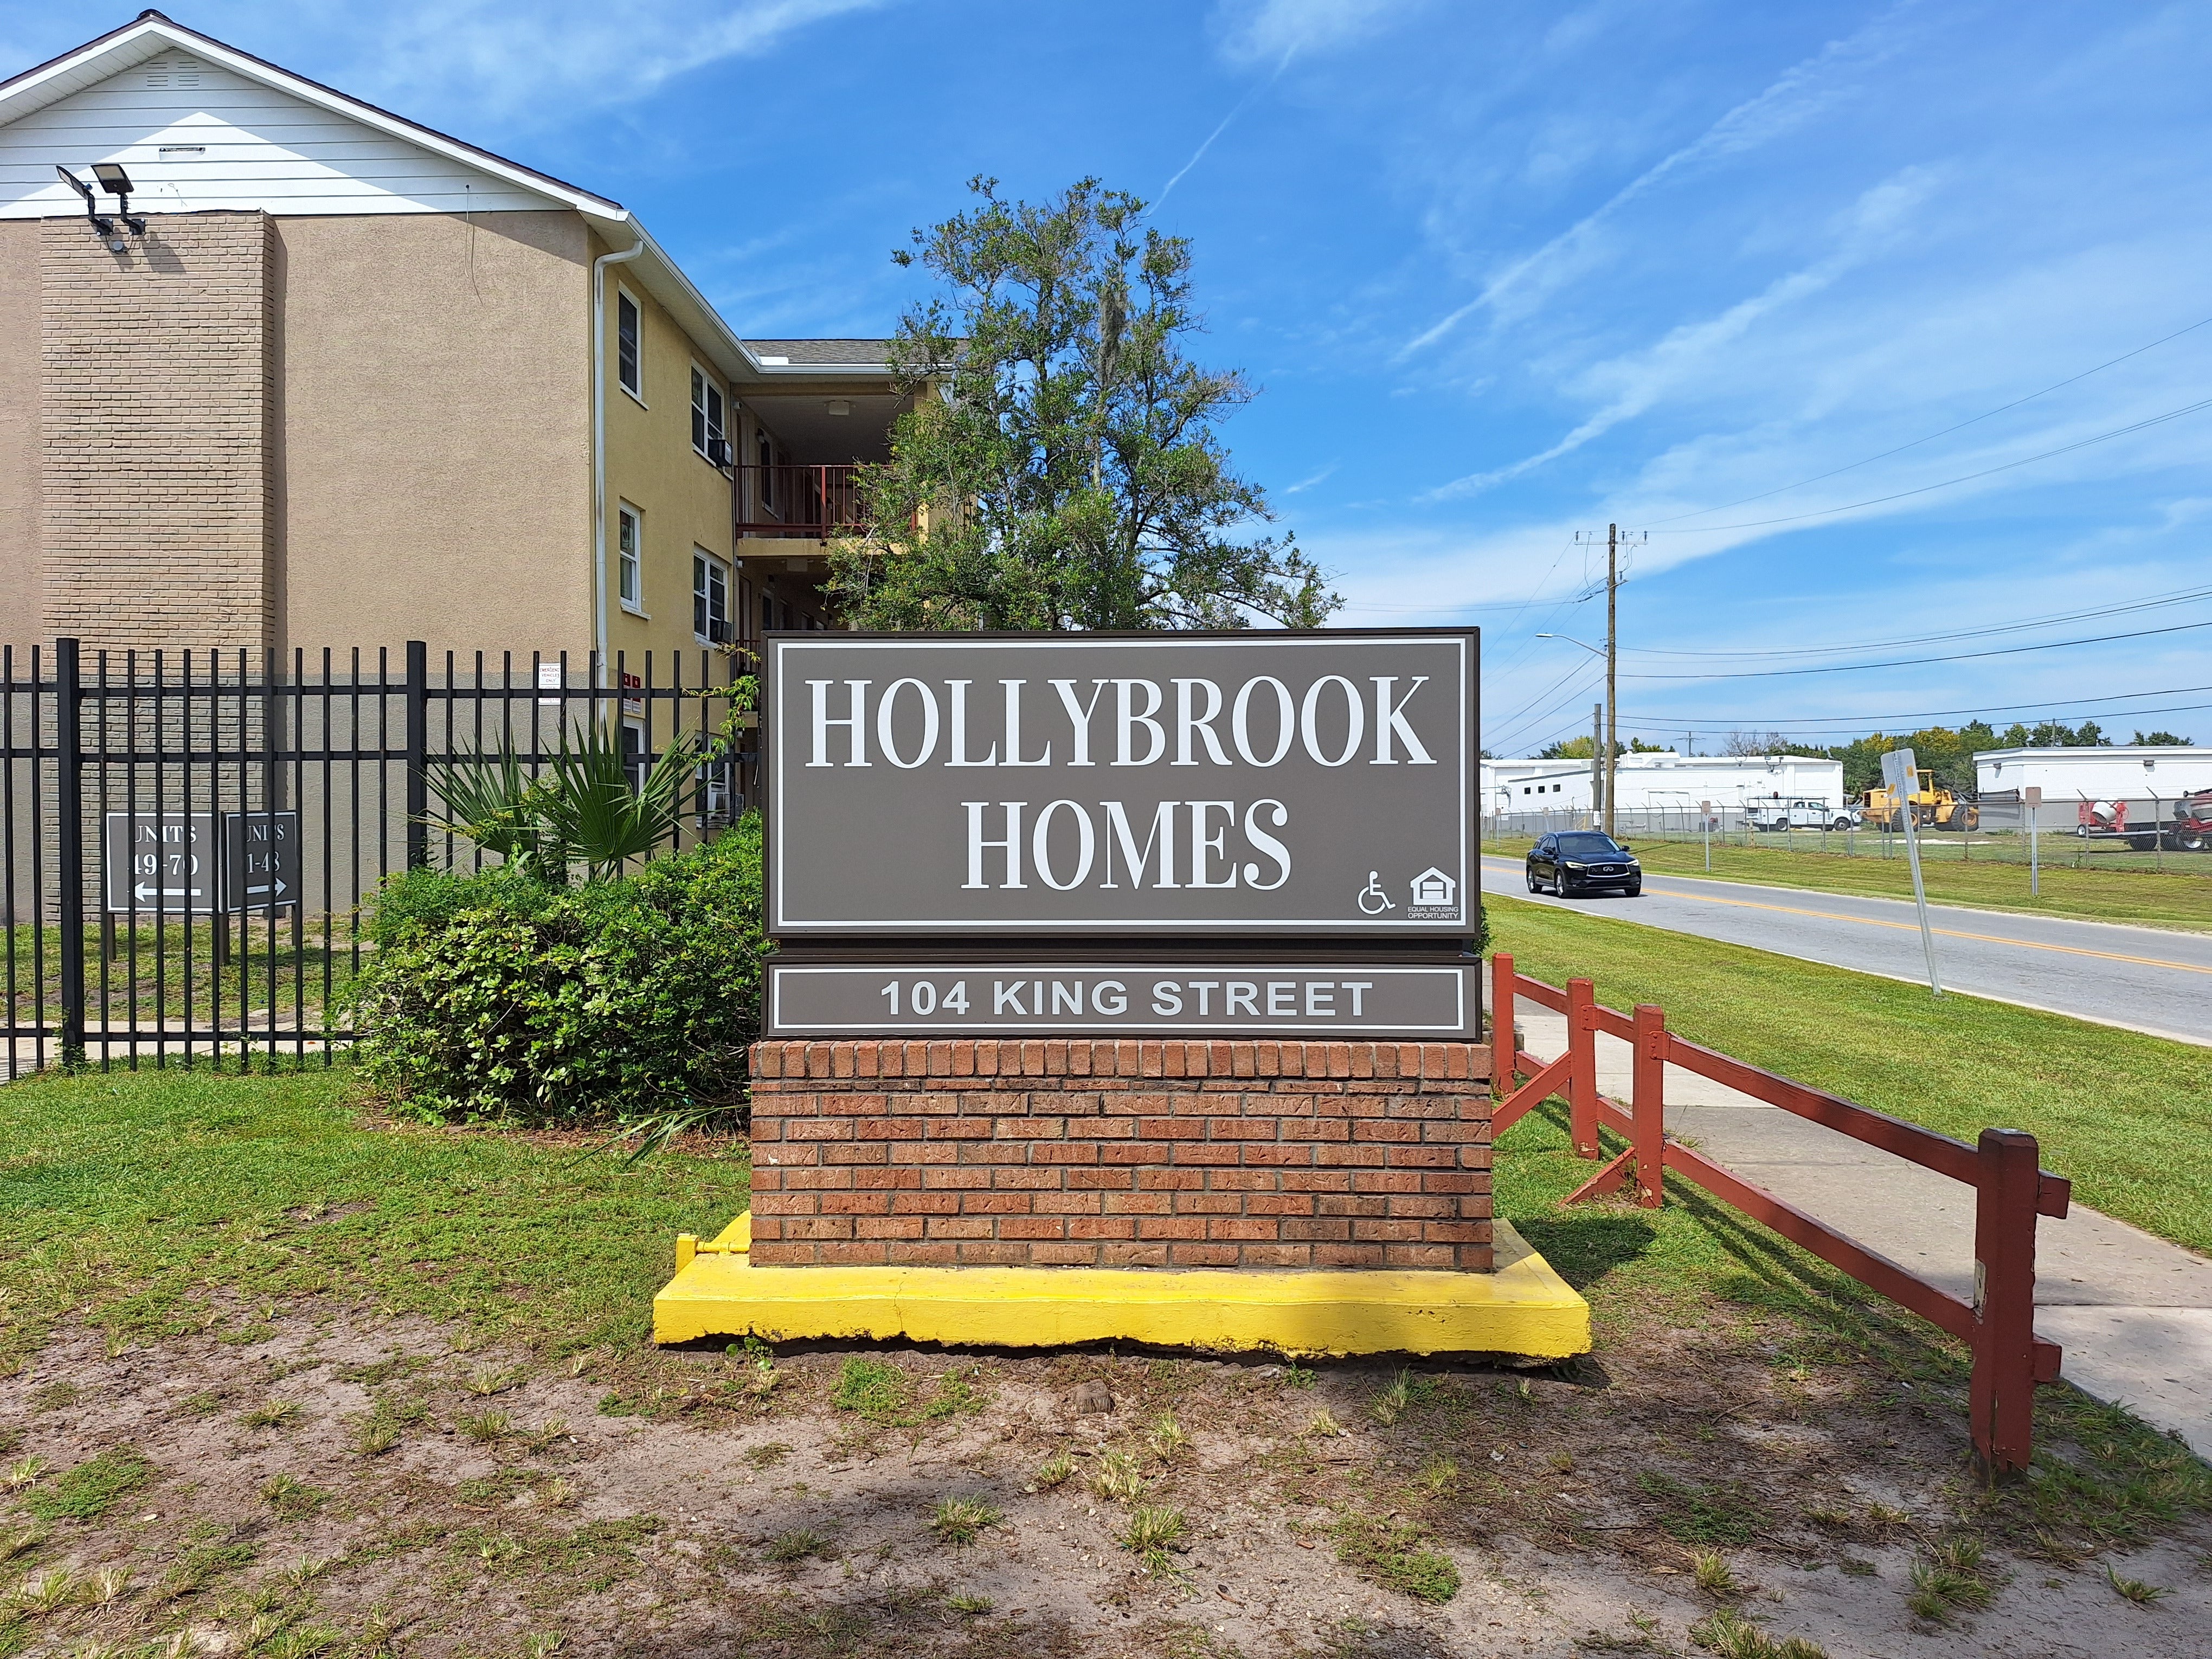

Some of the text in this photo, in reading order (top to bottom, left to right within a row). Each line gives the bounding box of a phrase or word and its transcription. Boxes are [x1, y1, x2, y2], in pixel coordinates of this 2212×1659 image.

[805, 675, 1438, 769] HOLLYBROOK
[961, 799, 1291, 891] HOMES
[881, 980, 1373, 1017] 104 KING STREET
